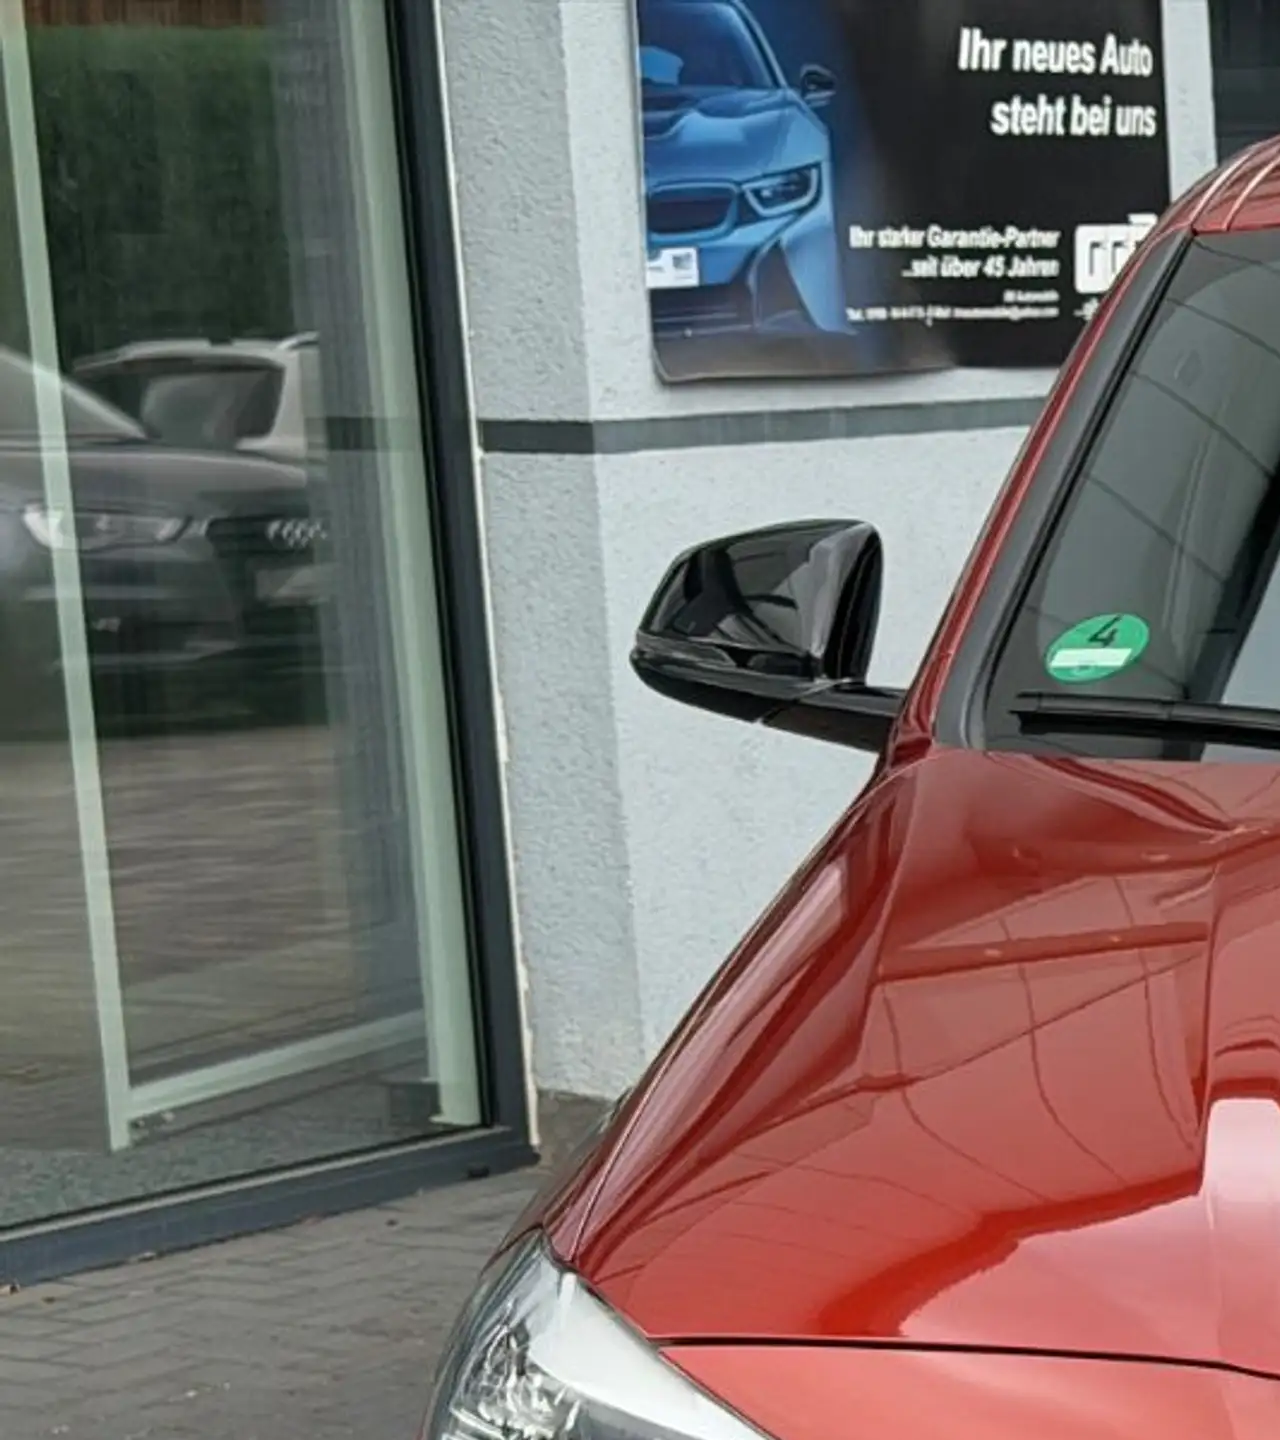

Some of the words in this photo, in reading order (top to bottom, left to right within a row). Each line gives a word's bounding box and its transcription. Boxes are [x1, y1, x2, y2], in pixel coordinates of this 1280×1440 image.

[957, 26, 1007, 72] Ihr
[1012, 38, 1096, 74] neues
[1099, 32, 1153, 77] Auto
[990, 93, 1066, 136] steht
[1070, 94, 1112, 136] bei
[1115, 103, 1157, 137] uns
[849, 225, 875, 249] Ihr
[926, 223, 1061, 249] Garantie-Partner
[940, 255, 981, 278] über
[982, 254, 1005, 278] 45
[1086, 614, 1123, 648] 4
